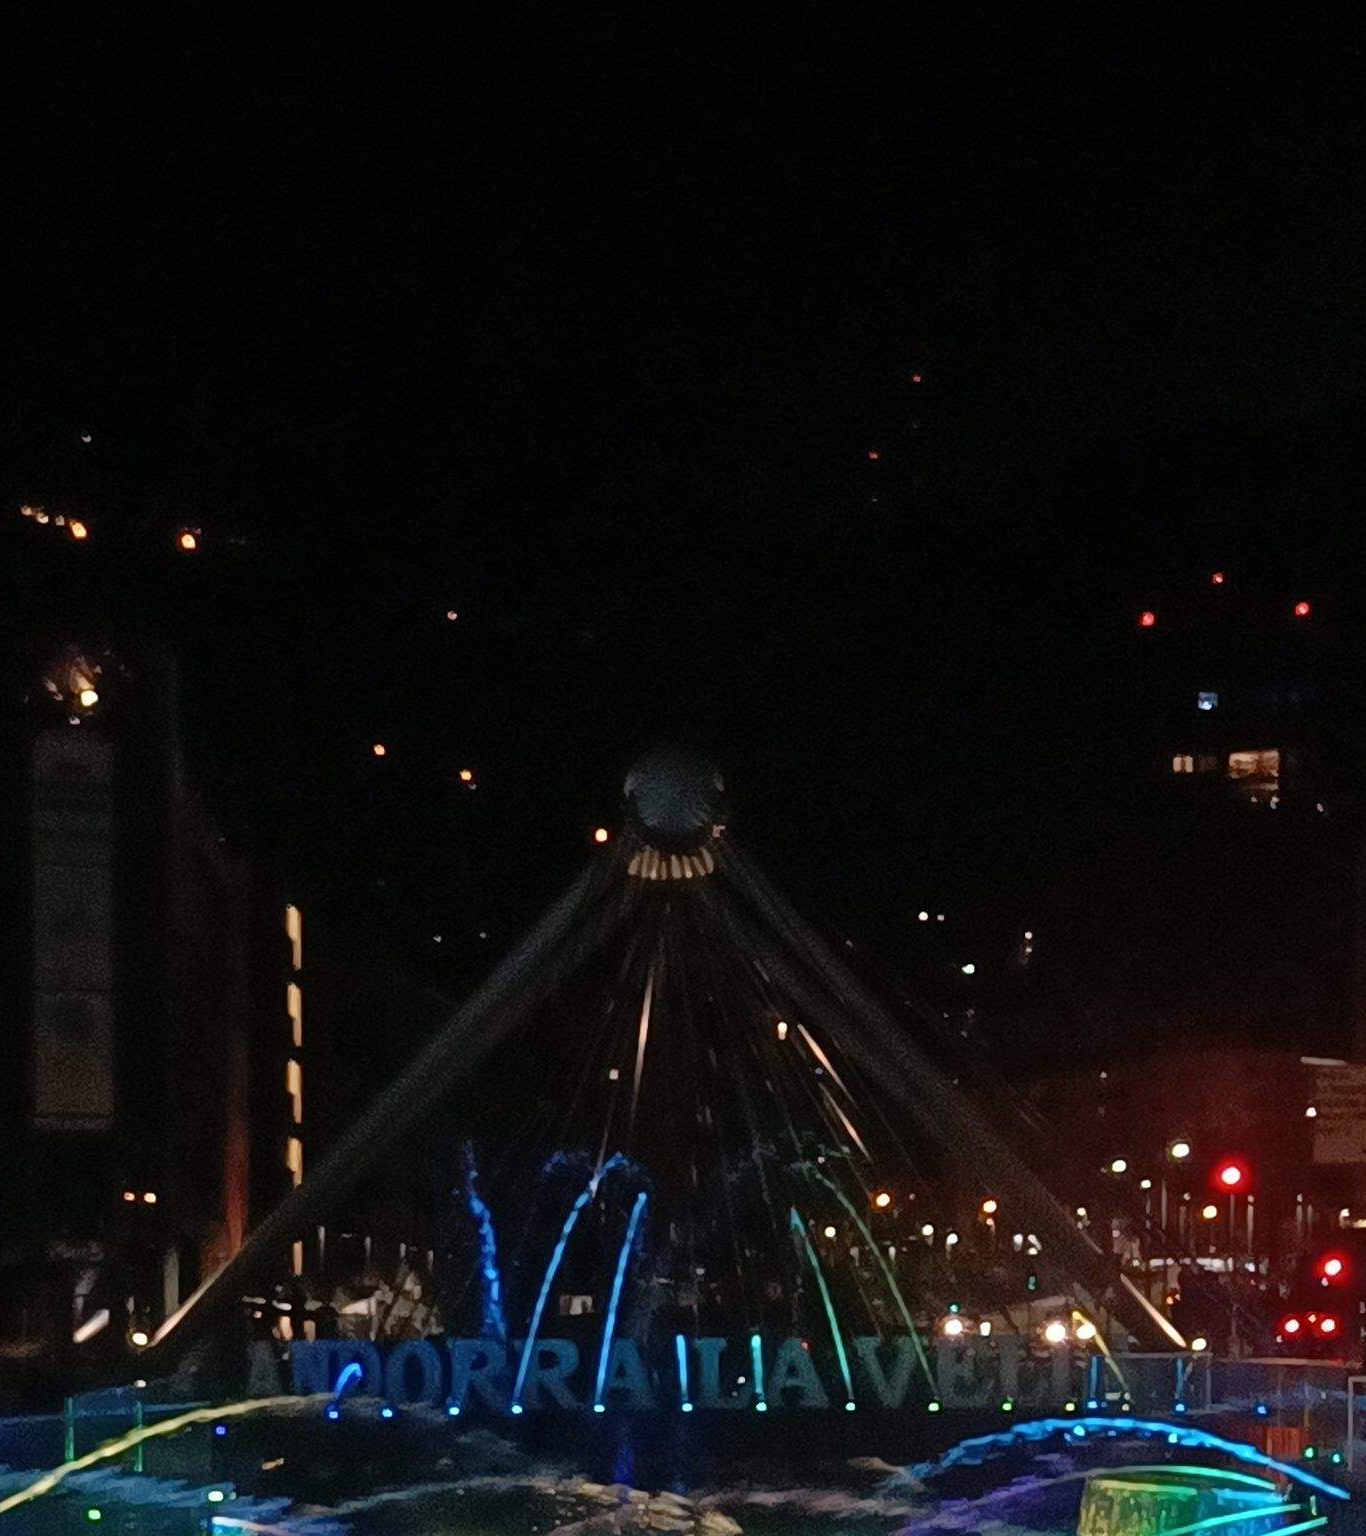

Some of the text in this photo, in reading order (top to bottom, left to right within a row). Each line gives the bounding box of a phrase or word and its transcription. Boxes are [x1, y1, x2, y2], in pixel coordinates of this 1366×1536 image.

[246, 1334, 1117, 1410] ANDORRA LA VELL
